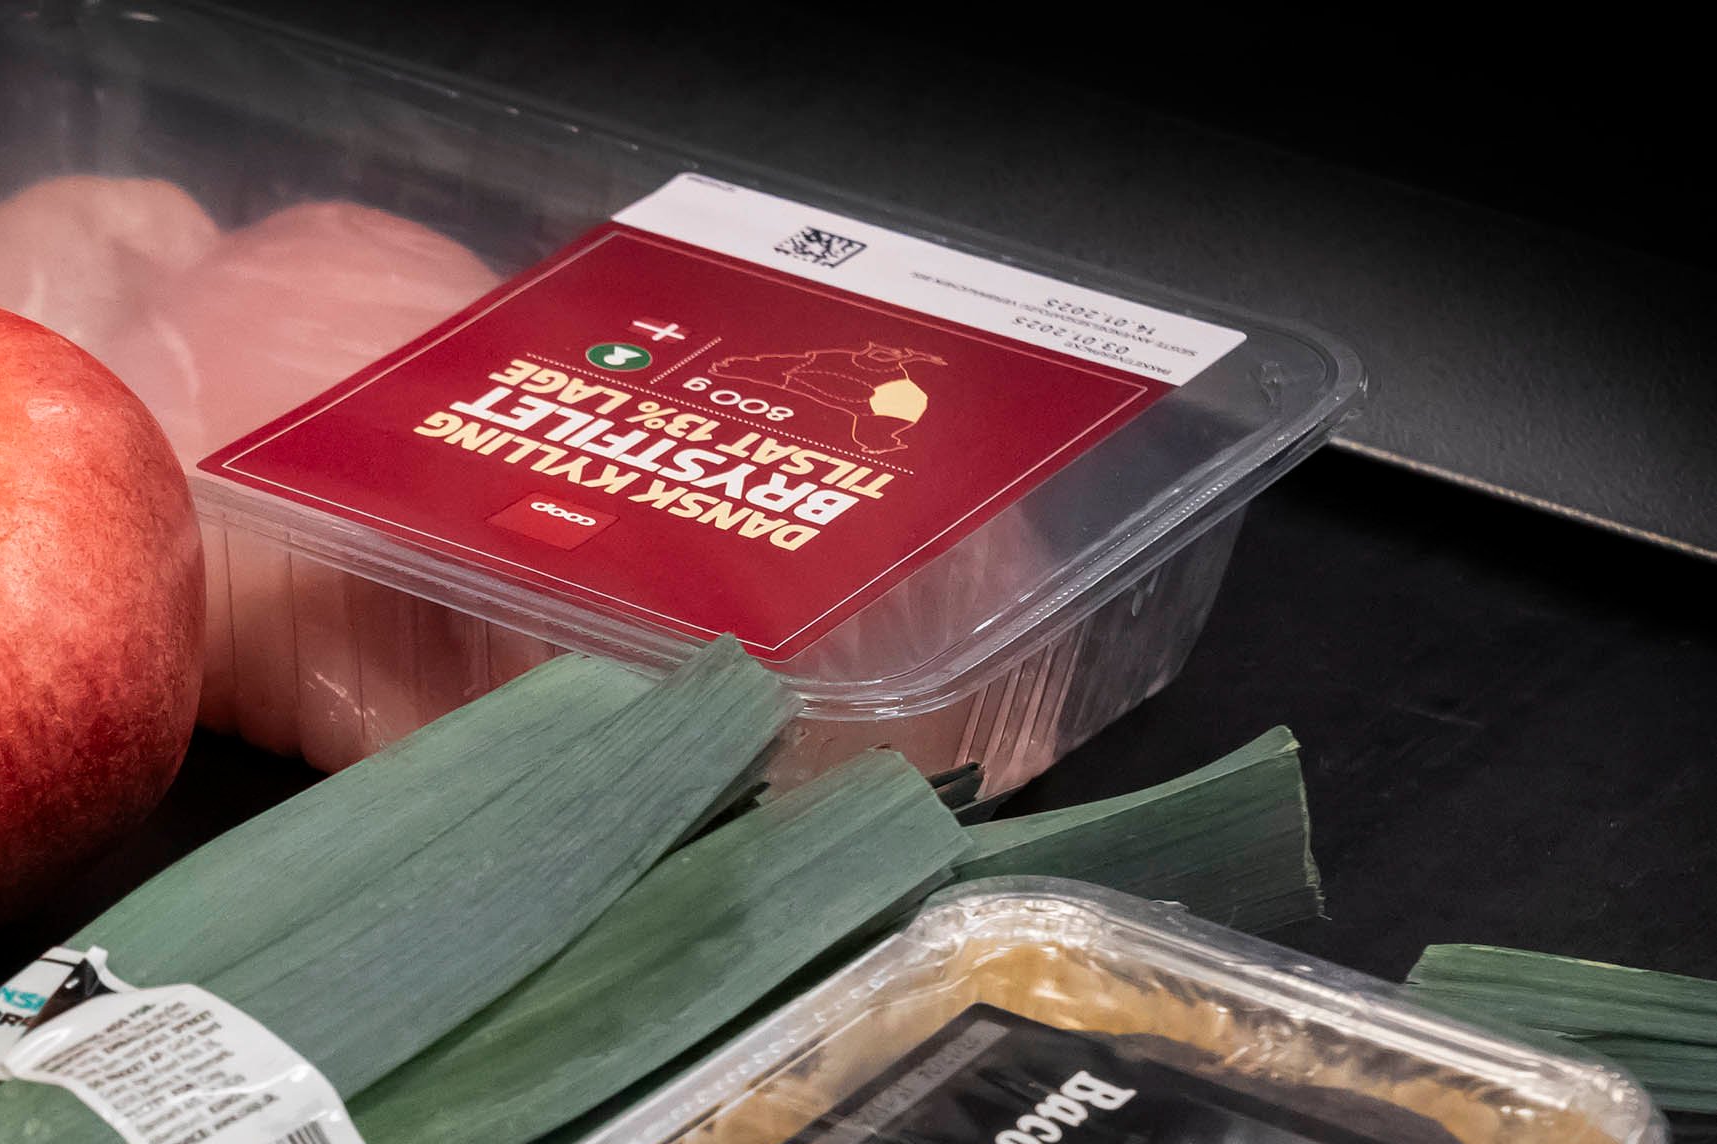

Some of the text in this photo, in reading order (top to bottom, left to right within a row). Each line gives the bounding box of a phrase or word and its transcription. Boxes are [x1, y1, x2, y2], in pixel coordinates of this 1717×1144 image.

[449, 386, 860, 526] BRYSTFILET
[489, 359, 895, 499] TILSAT 13% LAGE
[709, 389, 795, 422] 800
[413, 410, 820, 552] DANSK KYLLING
[530, 499, 598, 528] coop
